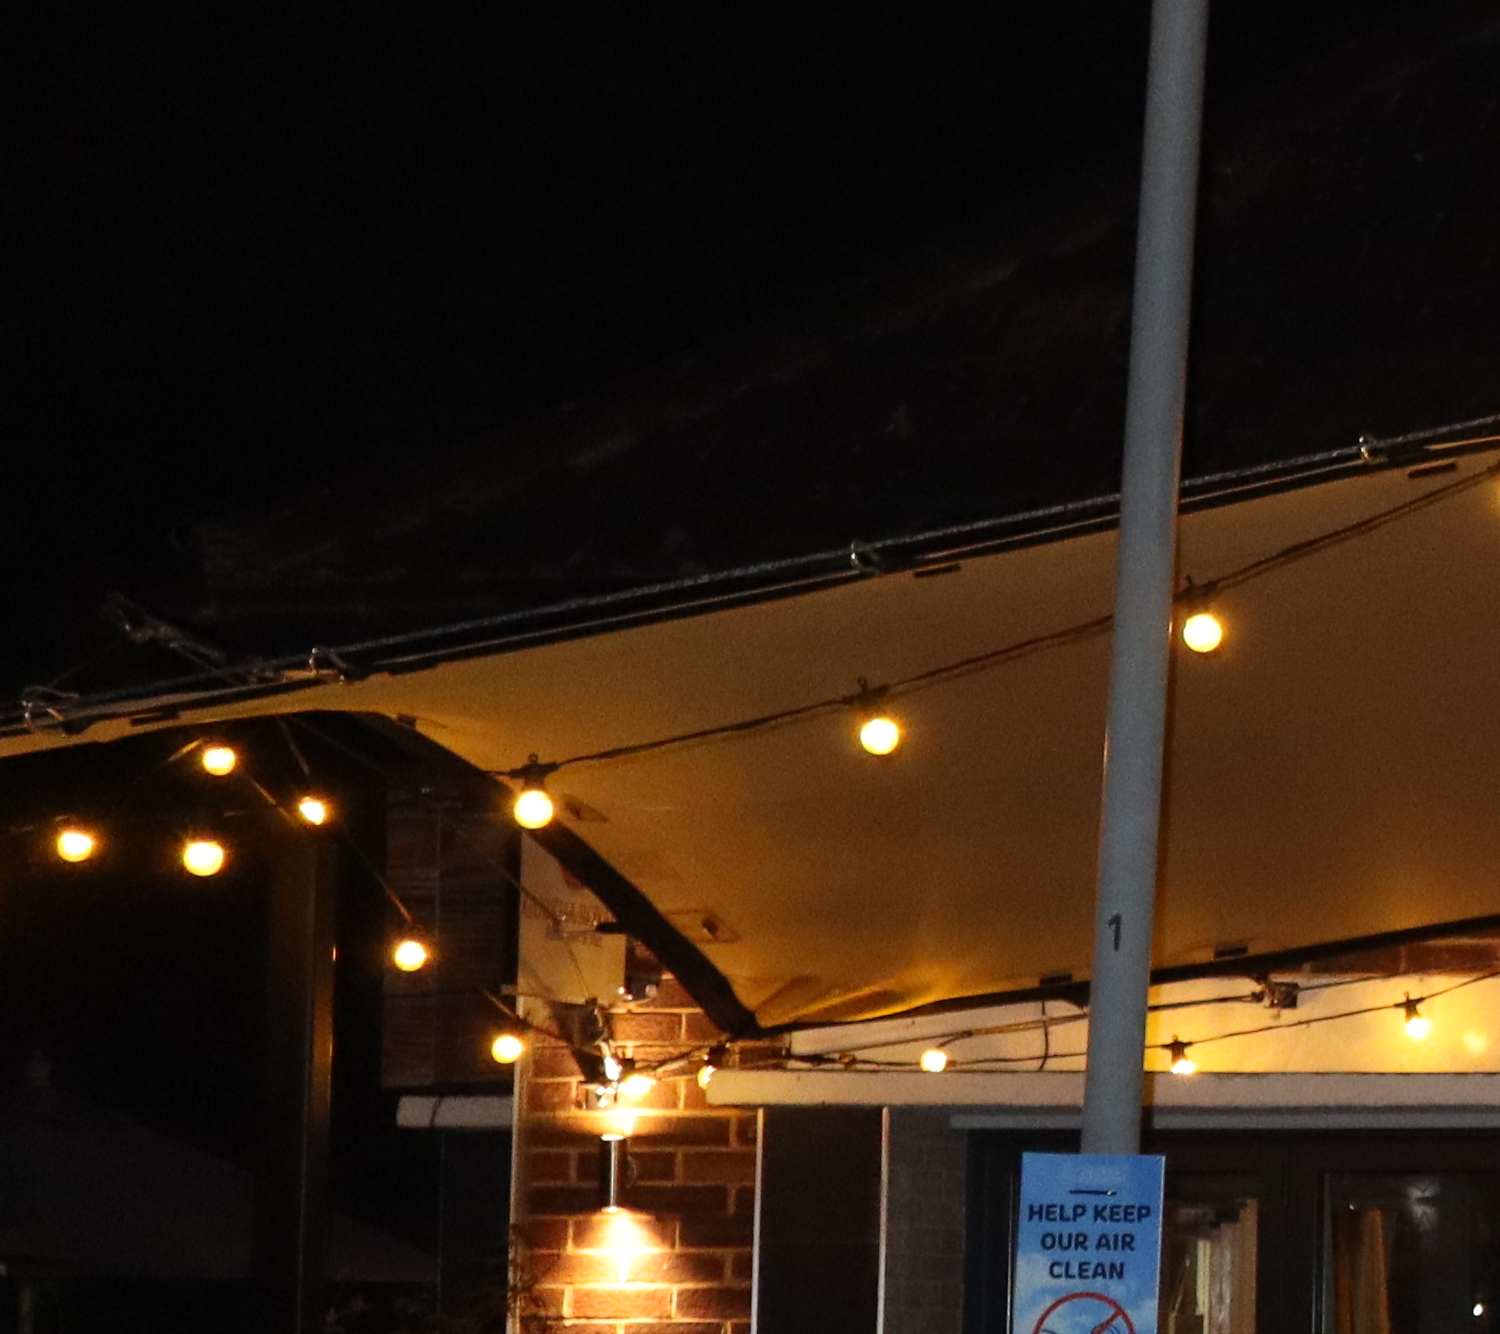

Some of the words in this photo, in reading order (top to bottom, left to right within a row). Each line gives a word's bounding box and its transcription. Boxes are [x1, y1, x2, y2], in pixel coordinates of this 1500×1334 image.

[1108, 913, 1121, 952] 1
[1028, 1203, 1086, 1223] HELP
[1093, 1204, 1152, 1224] KEEP
[1041, 1232, 1088, 1252] OUR
[1095, 1233, 1136, 1252] AIR
[1049, 1261, 1125, 1280] CLEAN
